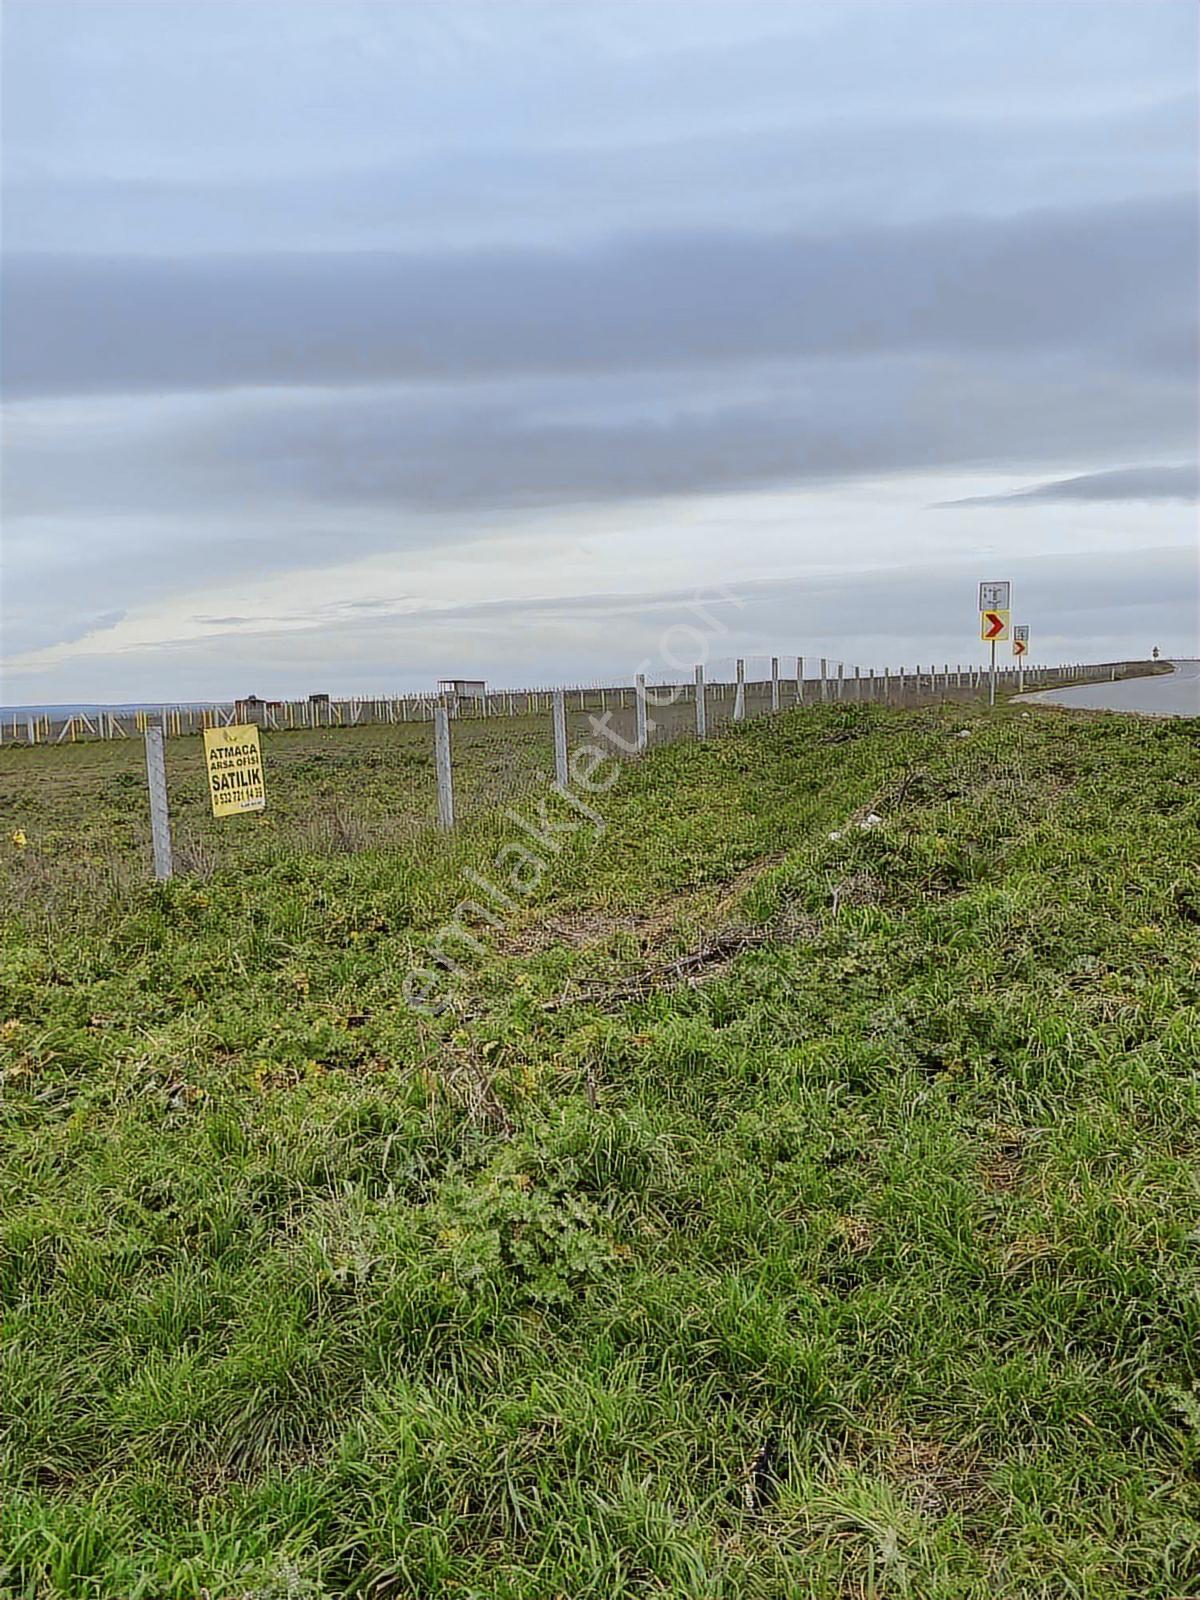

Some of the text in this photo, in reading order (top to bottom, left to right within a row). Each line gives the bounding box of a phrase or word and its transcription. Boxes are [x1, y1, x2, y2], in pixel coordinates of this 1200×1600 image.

[210, 744, 257, 760] ATMACA
[211, 760, 235, 770] ARSA
[212, 768, 261, 791] SATILIK
